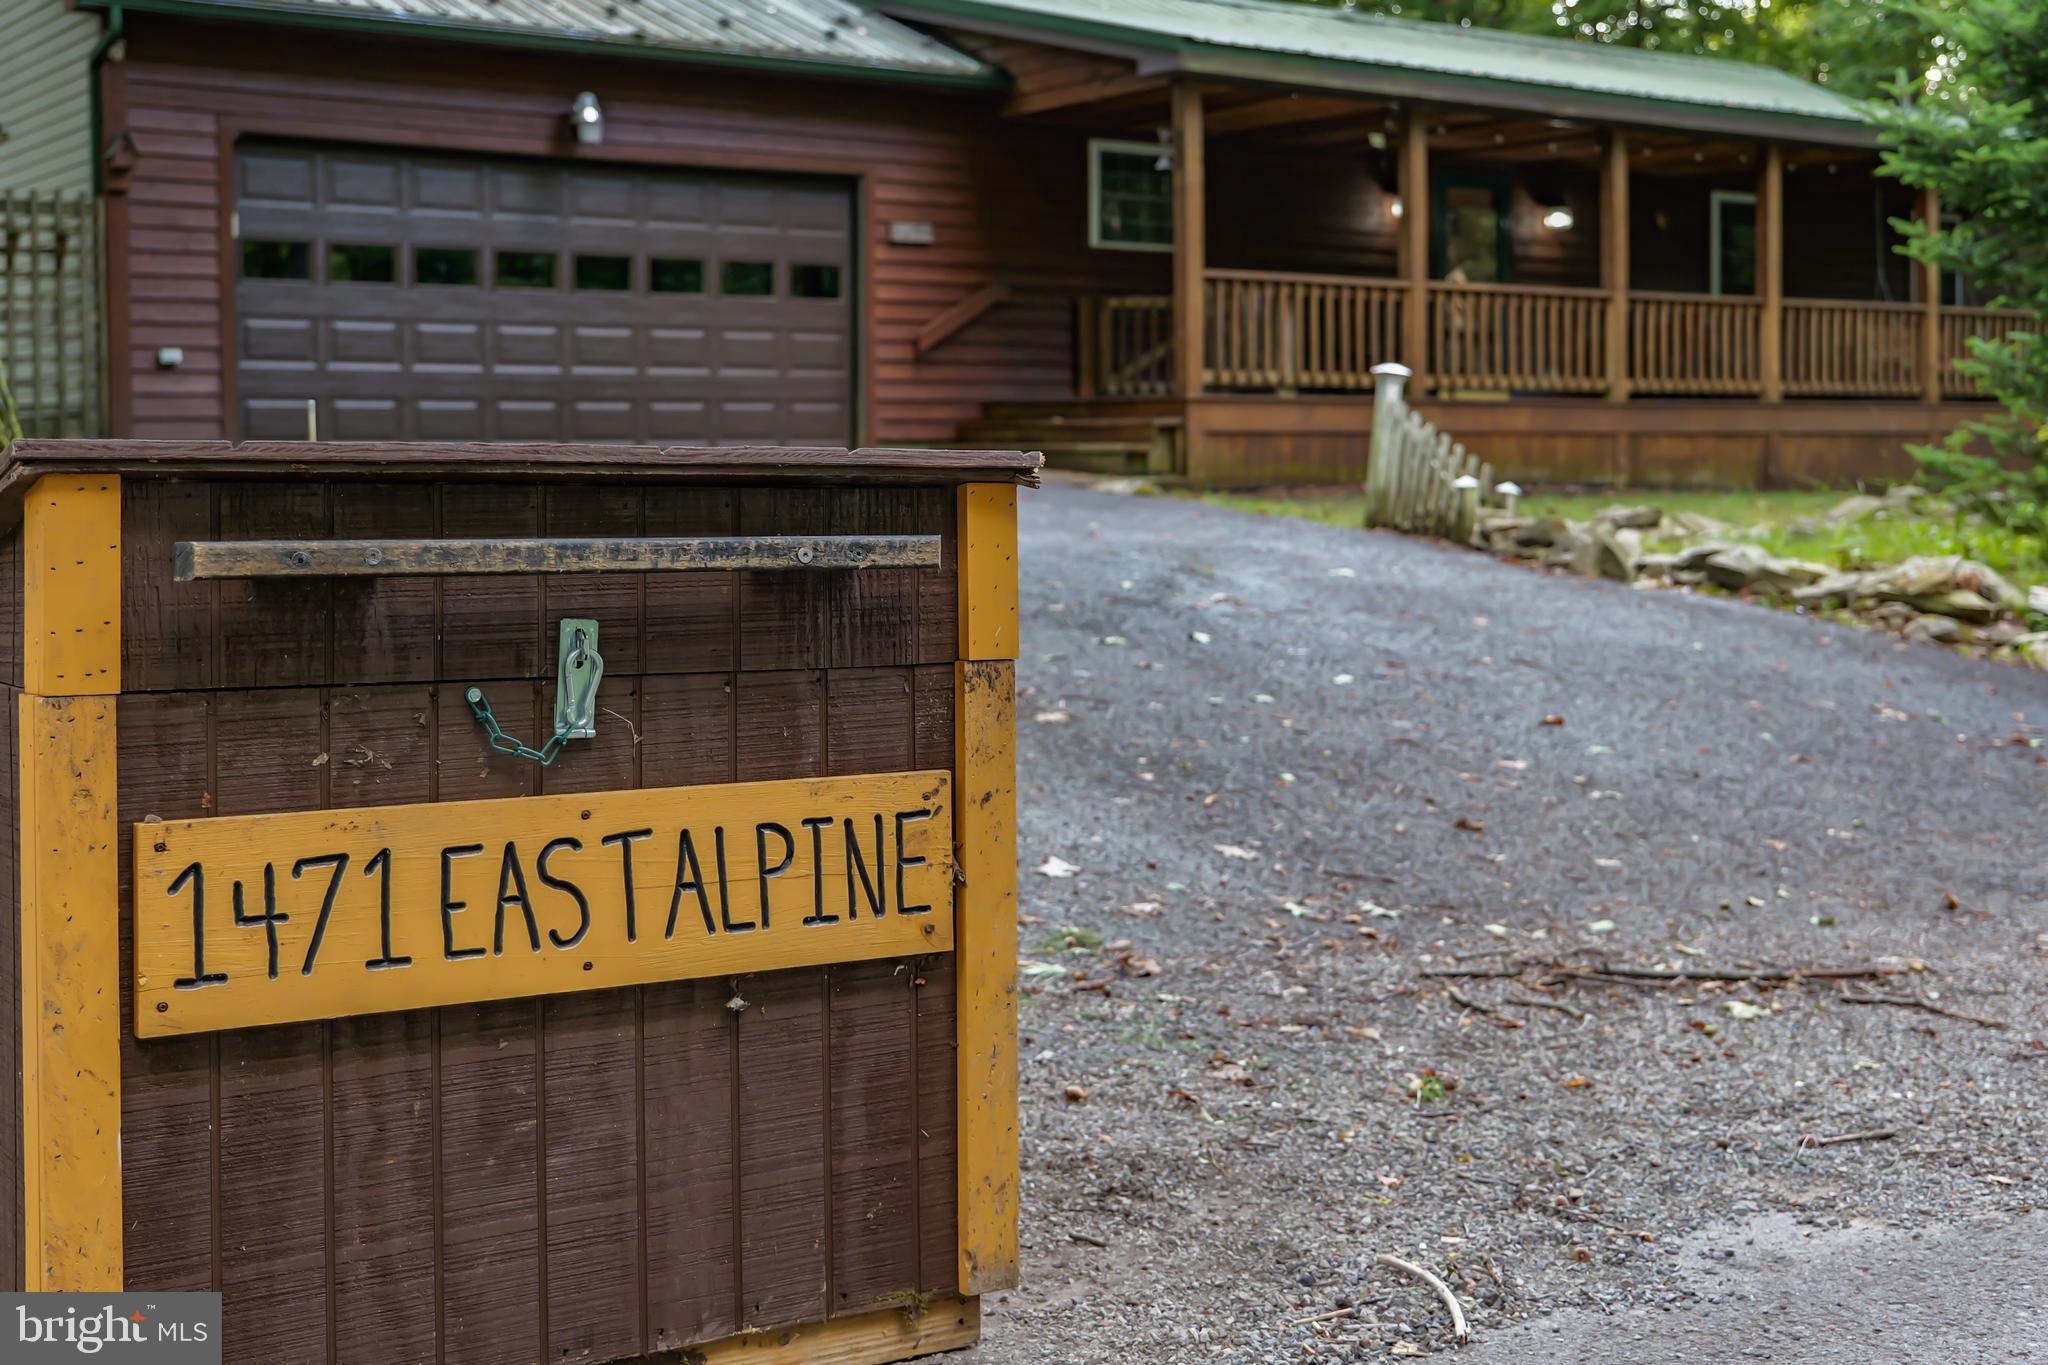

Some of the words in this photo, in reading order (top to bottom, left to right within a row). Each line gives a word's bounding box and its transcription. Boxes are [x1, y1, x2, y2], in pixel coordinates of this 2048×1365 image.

[167, 847, 412, 990] 1471
[441, 828, 653, 960] EAST
[664, 810, 932, 940] ALPINE
